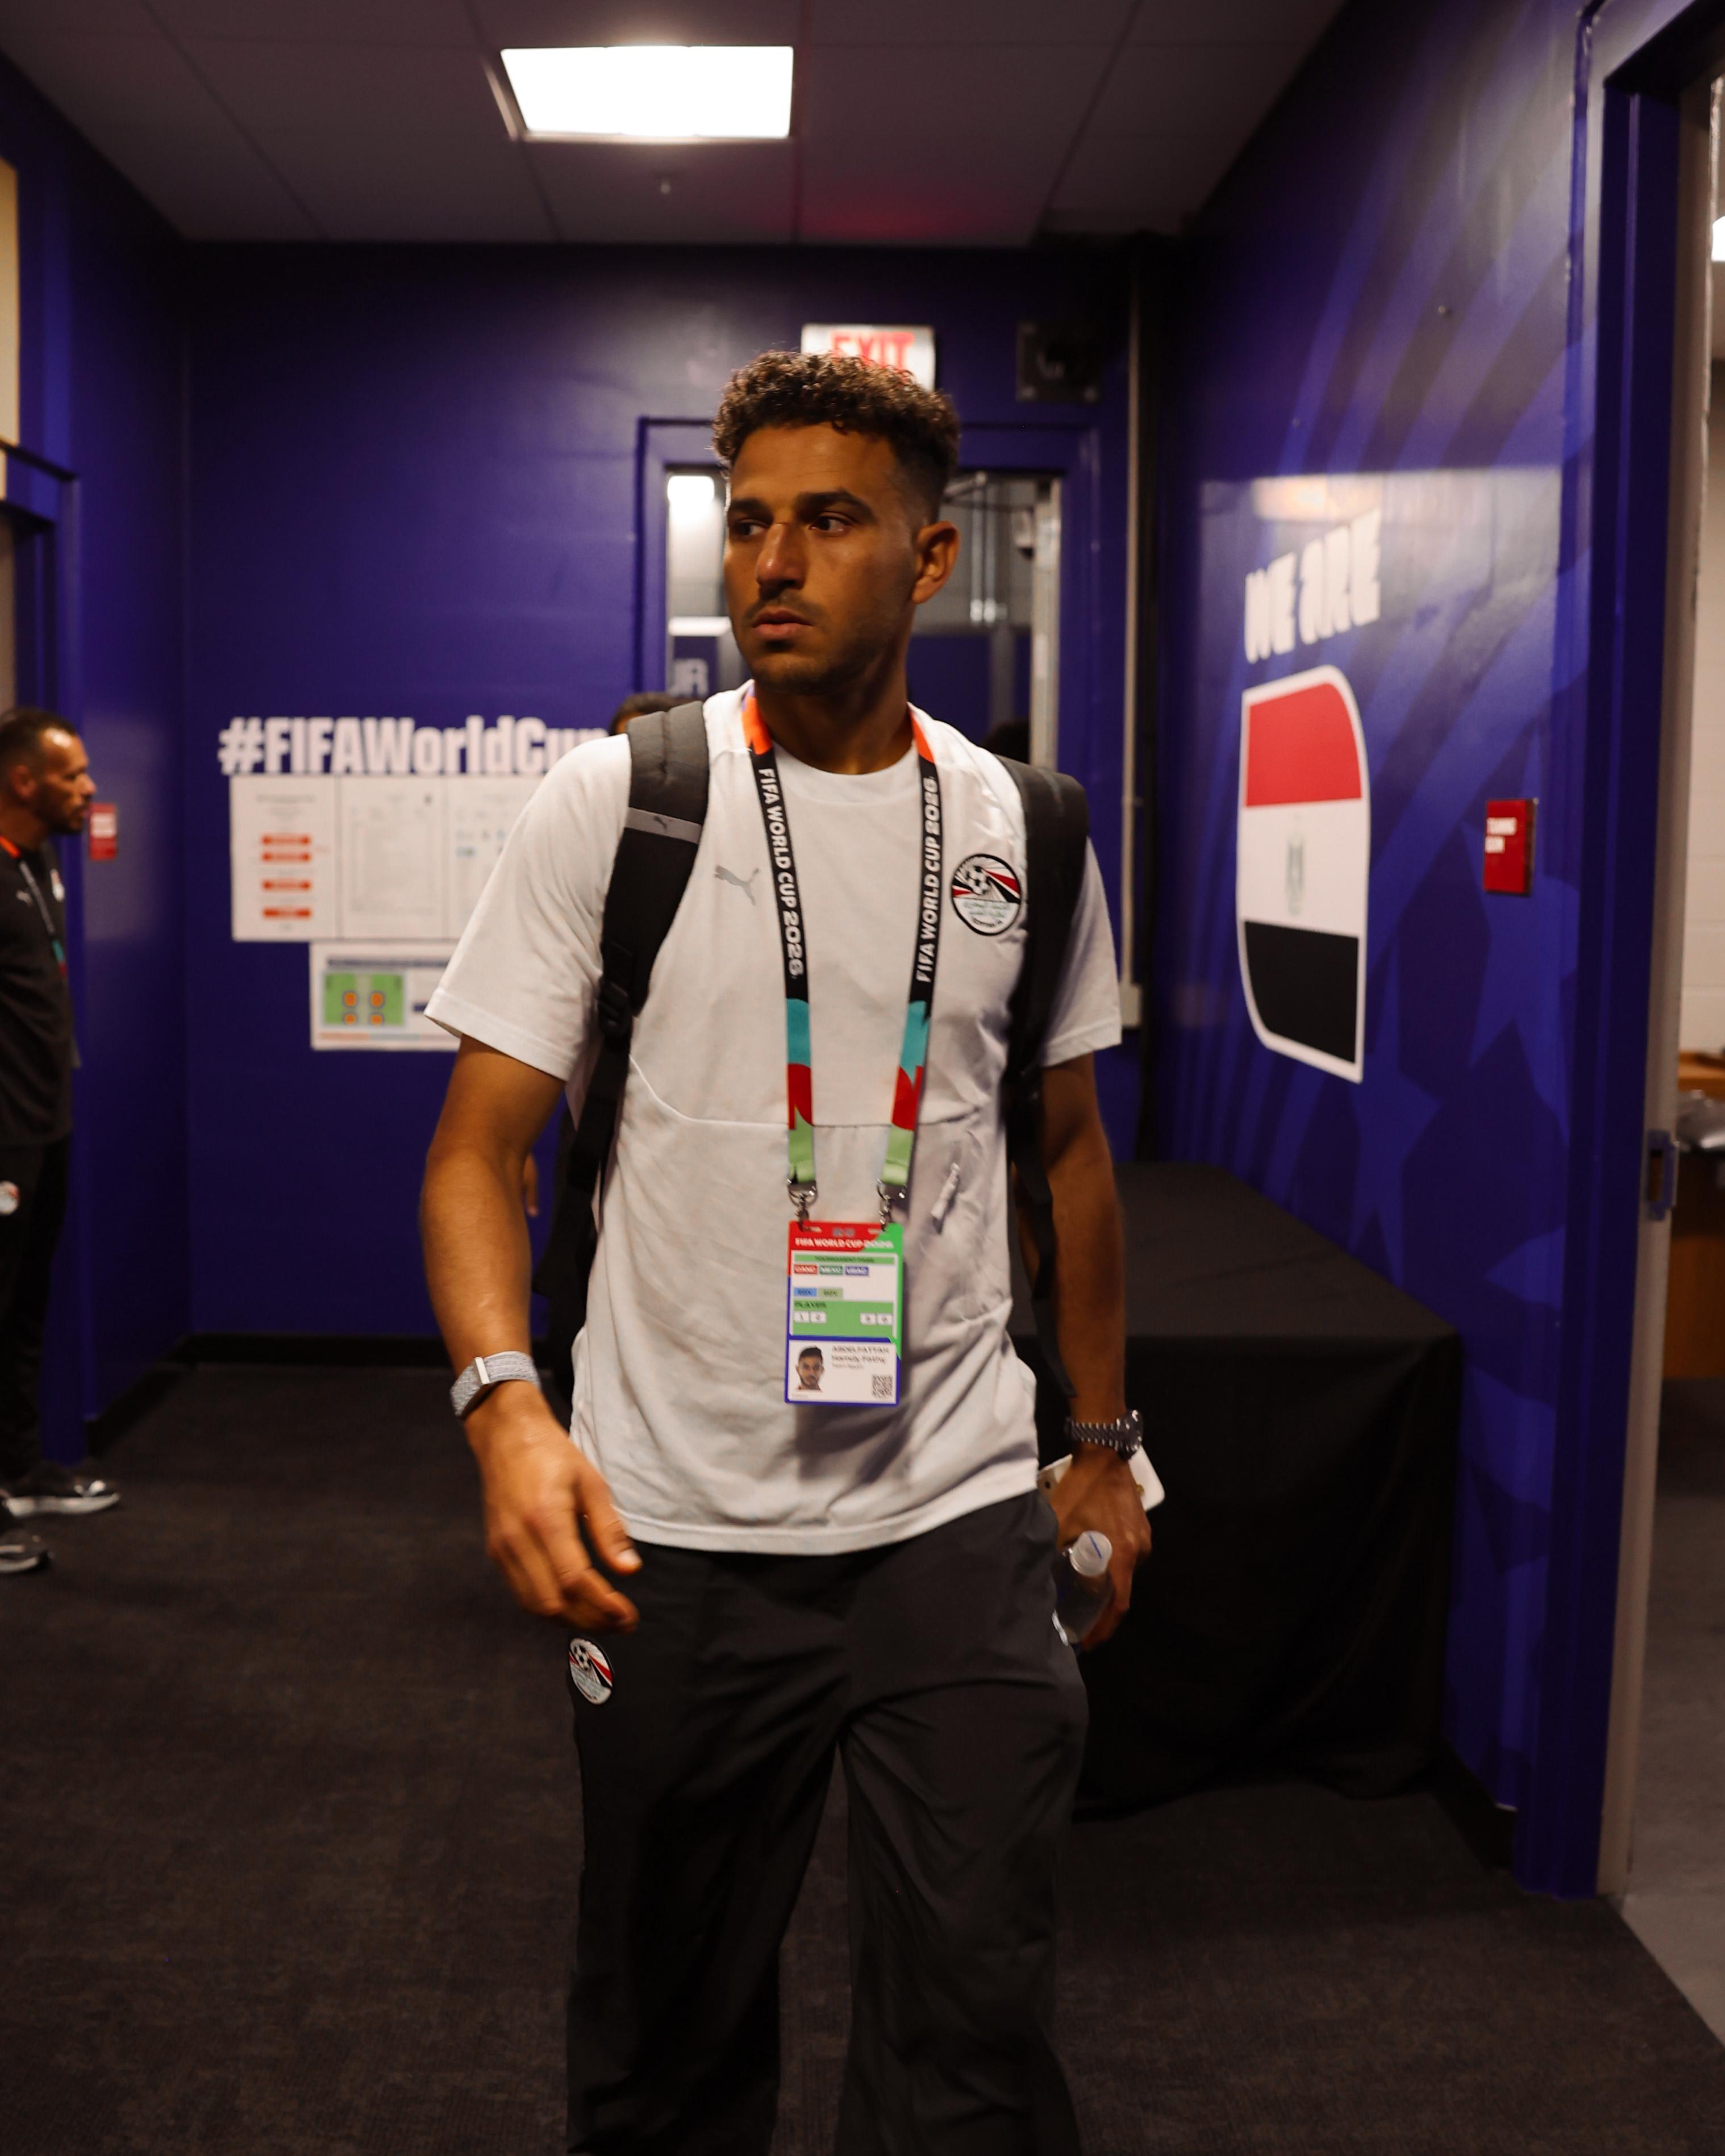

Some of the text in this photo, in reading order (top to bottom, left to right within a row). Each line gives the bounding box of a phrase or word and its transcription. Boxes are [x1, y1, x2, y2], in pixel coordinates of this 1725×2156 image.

[1244, 508, 1381, 664] WE ARE
[217, 716, 610, 775] #FIFAWorldCu
[758, 768, 805, 977] FIFA WORLD CUP 2026
[915, 777, 941, 983] FIFA WORLD CUP 2026
[795, 1237, 815, 1247] FIFA
[814, 1238, 845, 1248] WORLD
[845, 1239, 864, 1248] CUP
